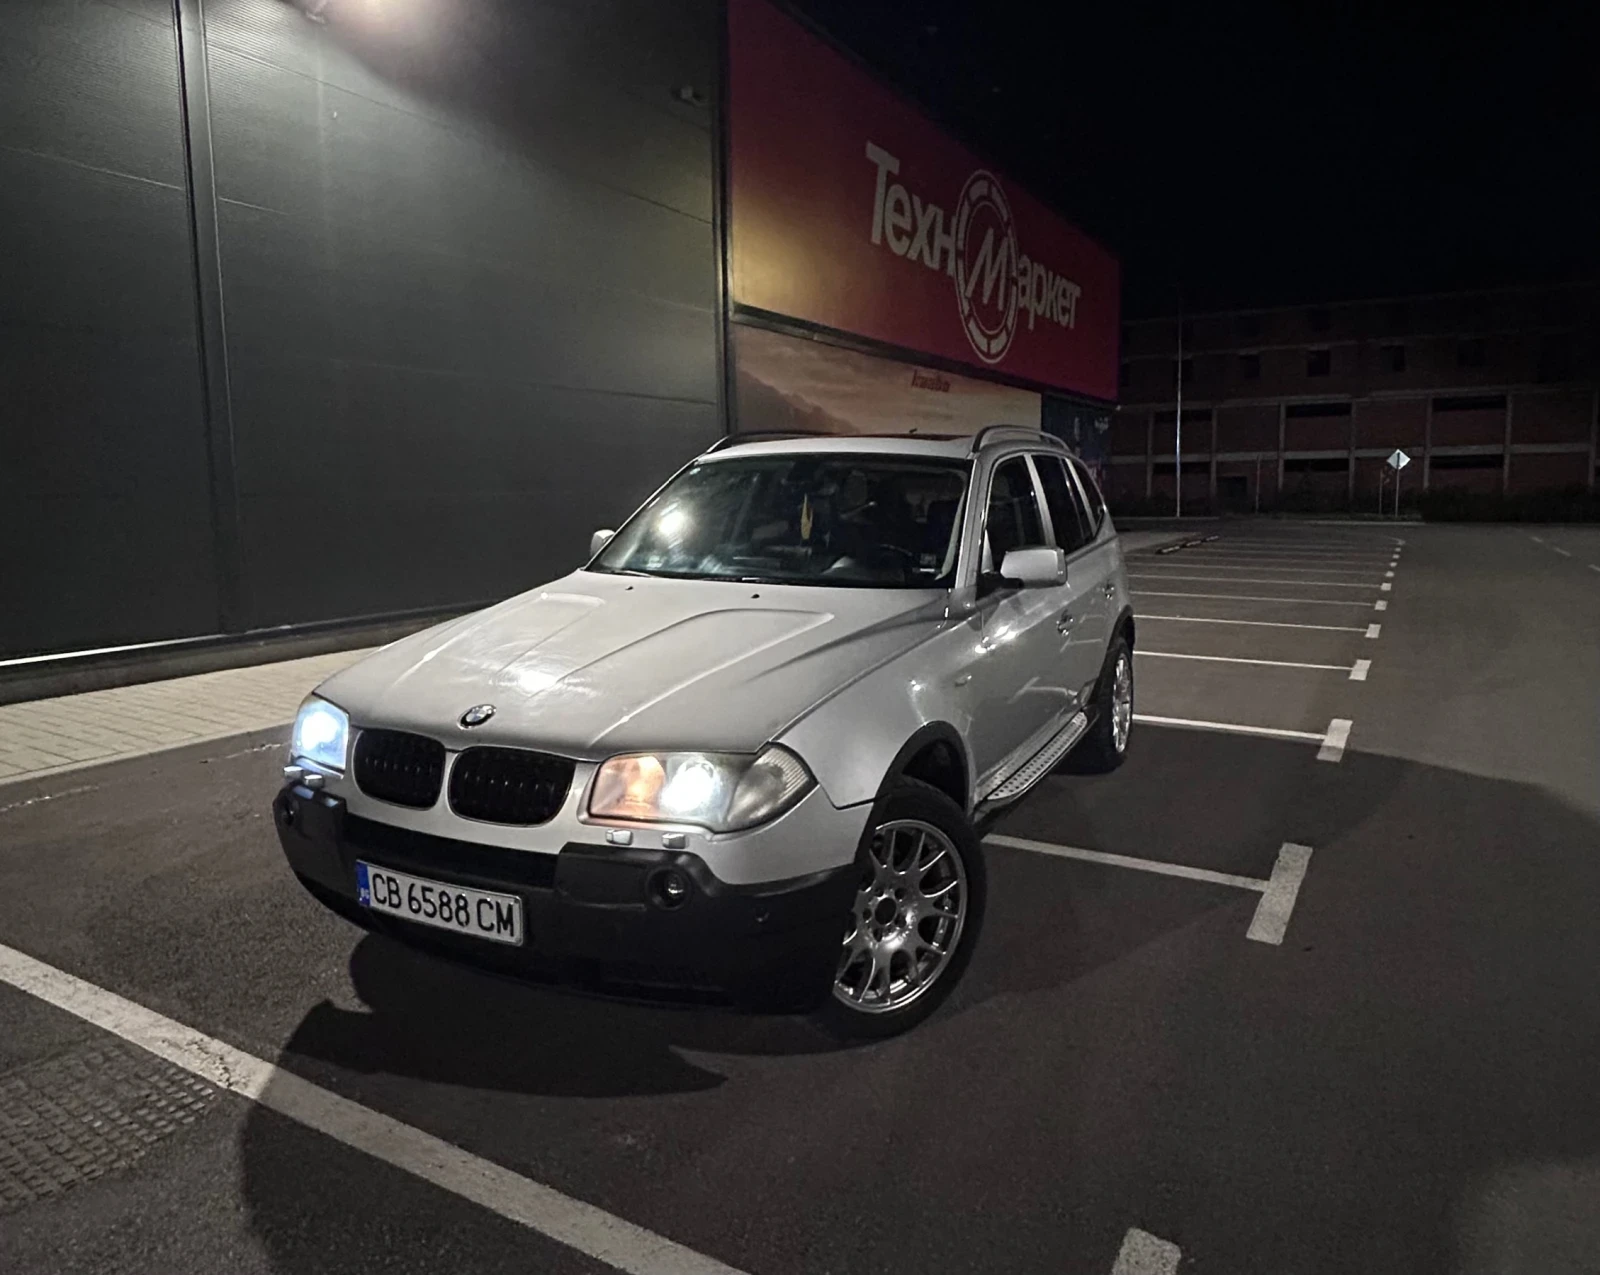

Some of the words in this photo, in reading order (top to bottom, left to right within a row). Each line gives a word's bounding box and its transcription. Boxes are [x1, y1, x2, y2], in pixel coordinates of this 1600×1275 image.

[372, 873, 401, 909] CB
[407, 883, 471, 927] 6588
[476, 898, 515, 937] CM
